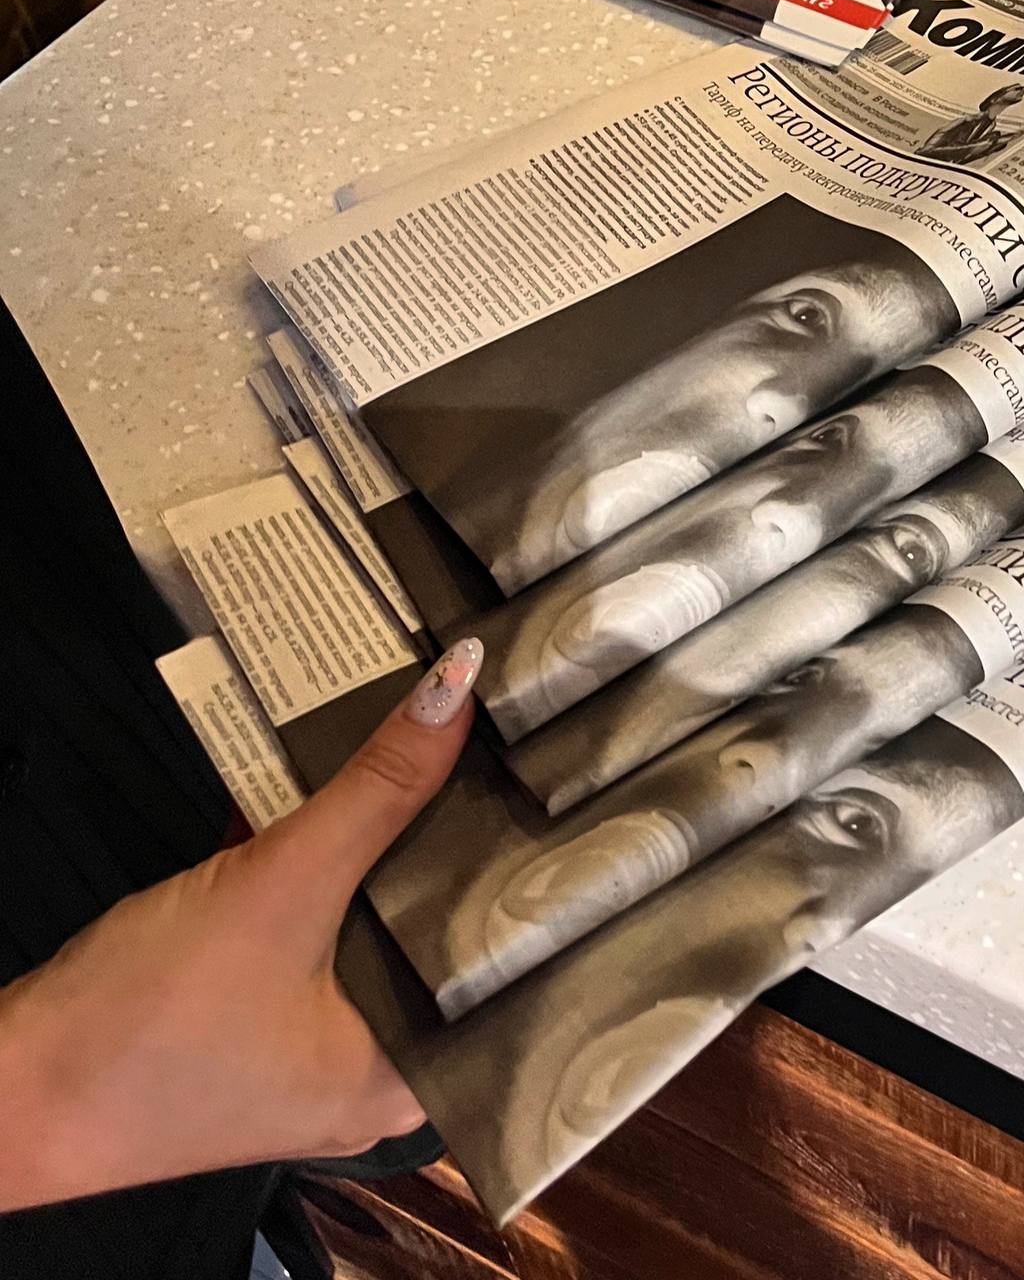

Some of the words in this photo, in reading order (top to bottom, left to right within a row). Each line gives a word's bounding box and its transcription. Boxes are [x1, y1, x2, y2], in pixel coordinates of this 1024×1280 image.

[702, 80, 742, 119] Тариф
[736, 115, 756, 133] на
[751, 130, 810, 173] передачу
[727, 62, 855, 163] Регионы
